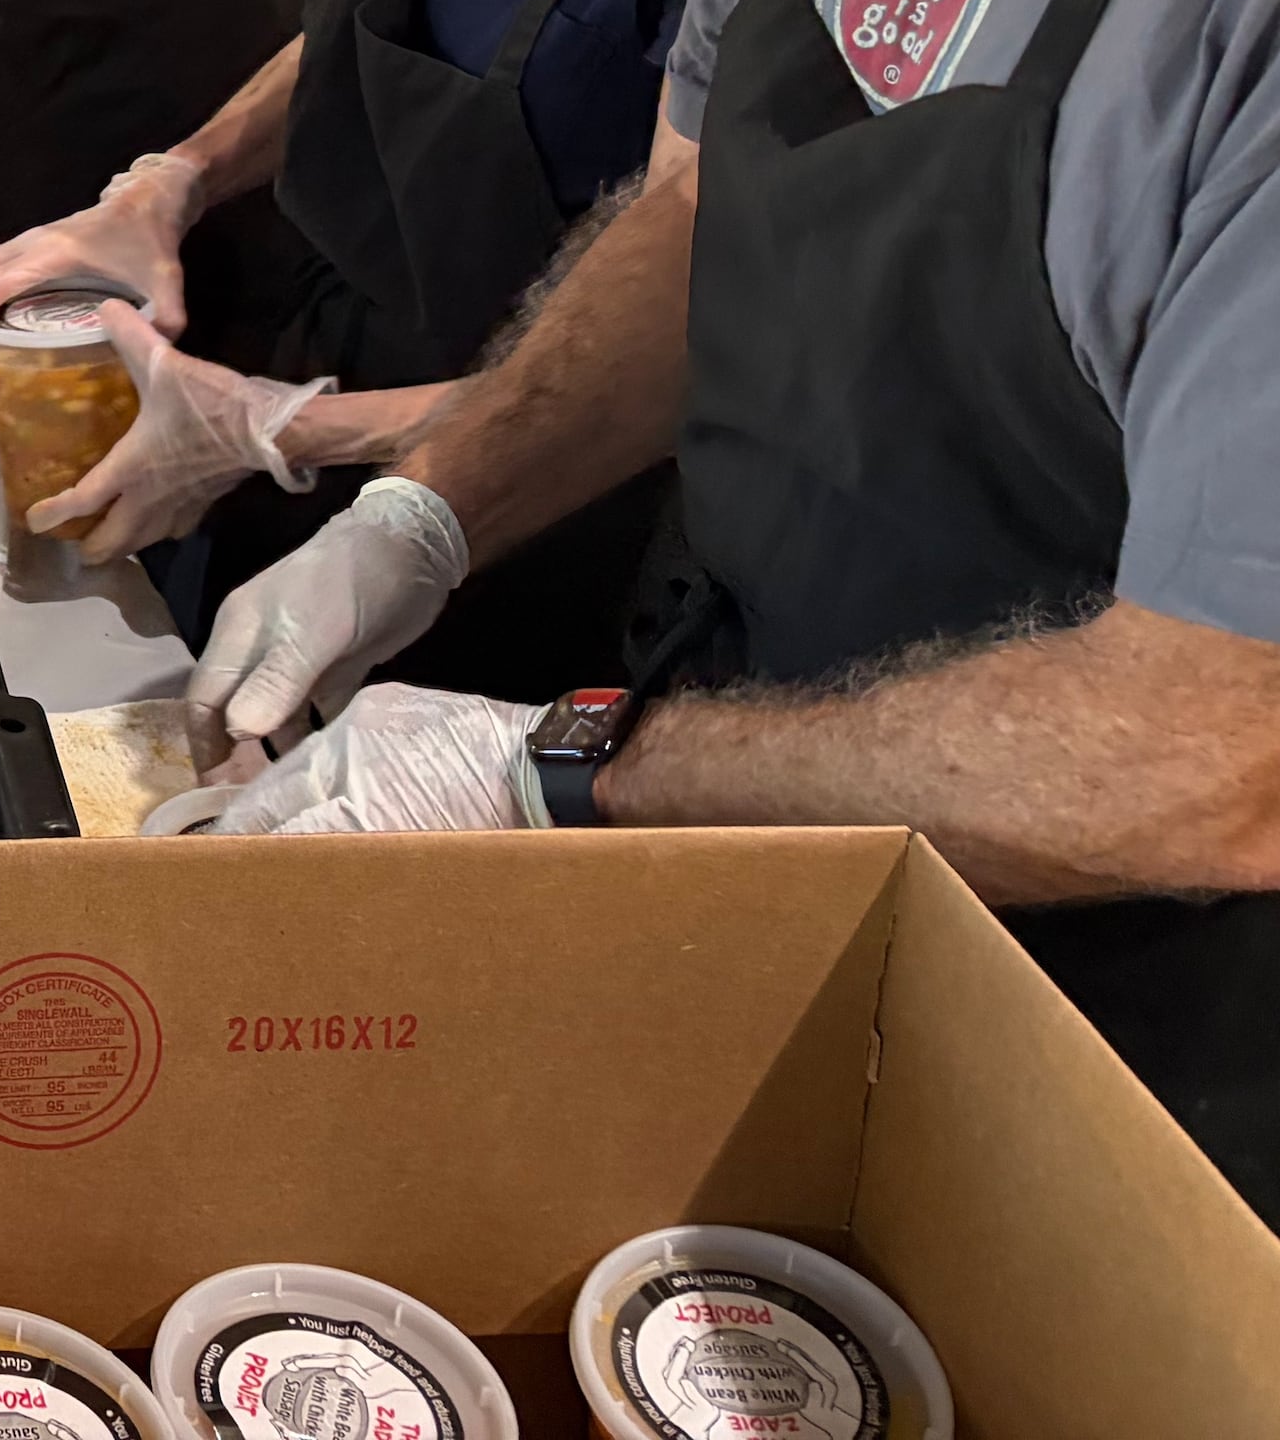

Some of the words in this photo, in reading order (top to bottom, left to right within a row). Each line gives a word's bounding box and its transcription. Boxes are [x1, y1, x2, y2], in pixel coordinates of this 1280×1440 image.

[851, 3, 934, 65] good
[26, 978, 114, 1008] CERTIFICATE
[17, 1007, 92, 1020] SINGLEWALL
[36, 1020, 52, 1029] ALL
[56, 1029, 67, 1037] OF
[226, 1013, 420, 1054] 20X16X12
[9, 1056, 48, 1066] CRUSH
[7, 1068, 35, 1077] (ECT)
[47, 1081, 65, 1093] 95
[46, 1100, 64, 1112] 95
[675, 1302, 774, 1325] PROJECT
[299, 1316, 323, 1331] You
[703, 1343, 770, 1357] Sausage
[694, 1365, 756, 1381] Chicken
[705, 1387, 748, 1402] Bean
[751, 1387, 800, 1403] White
[728, 1414, 800, 1431] ZADIE
